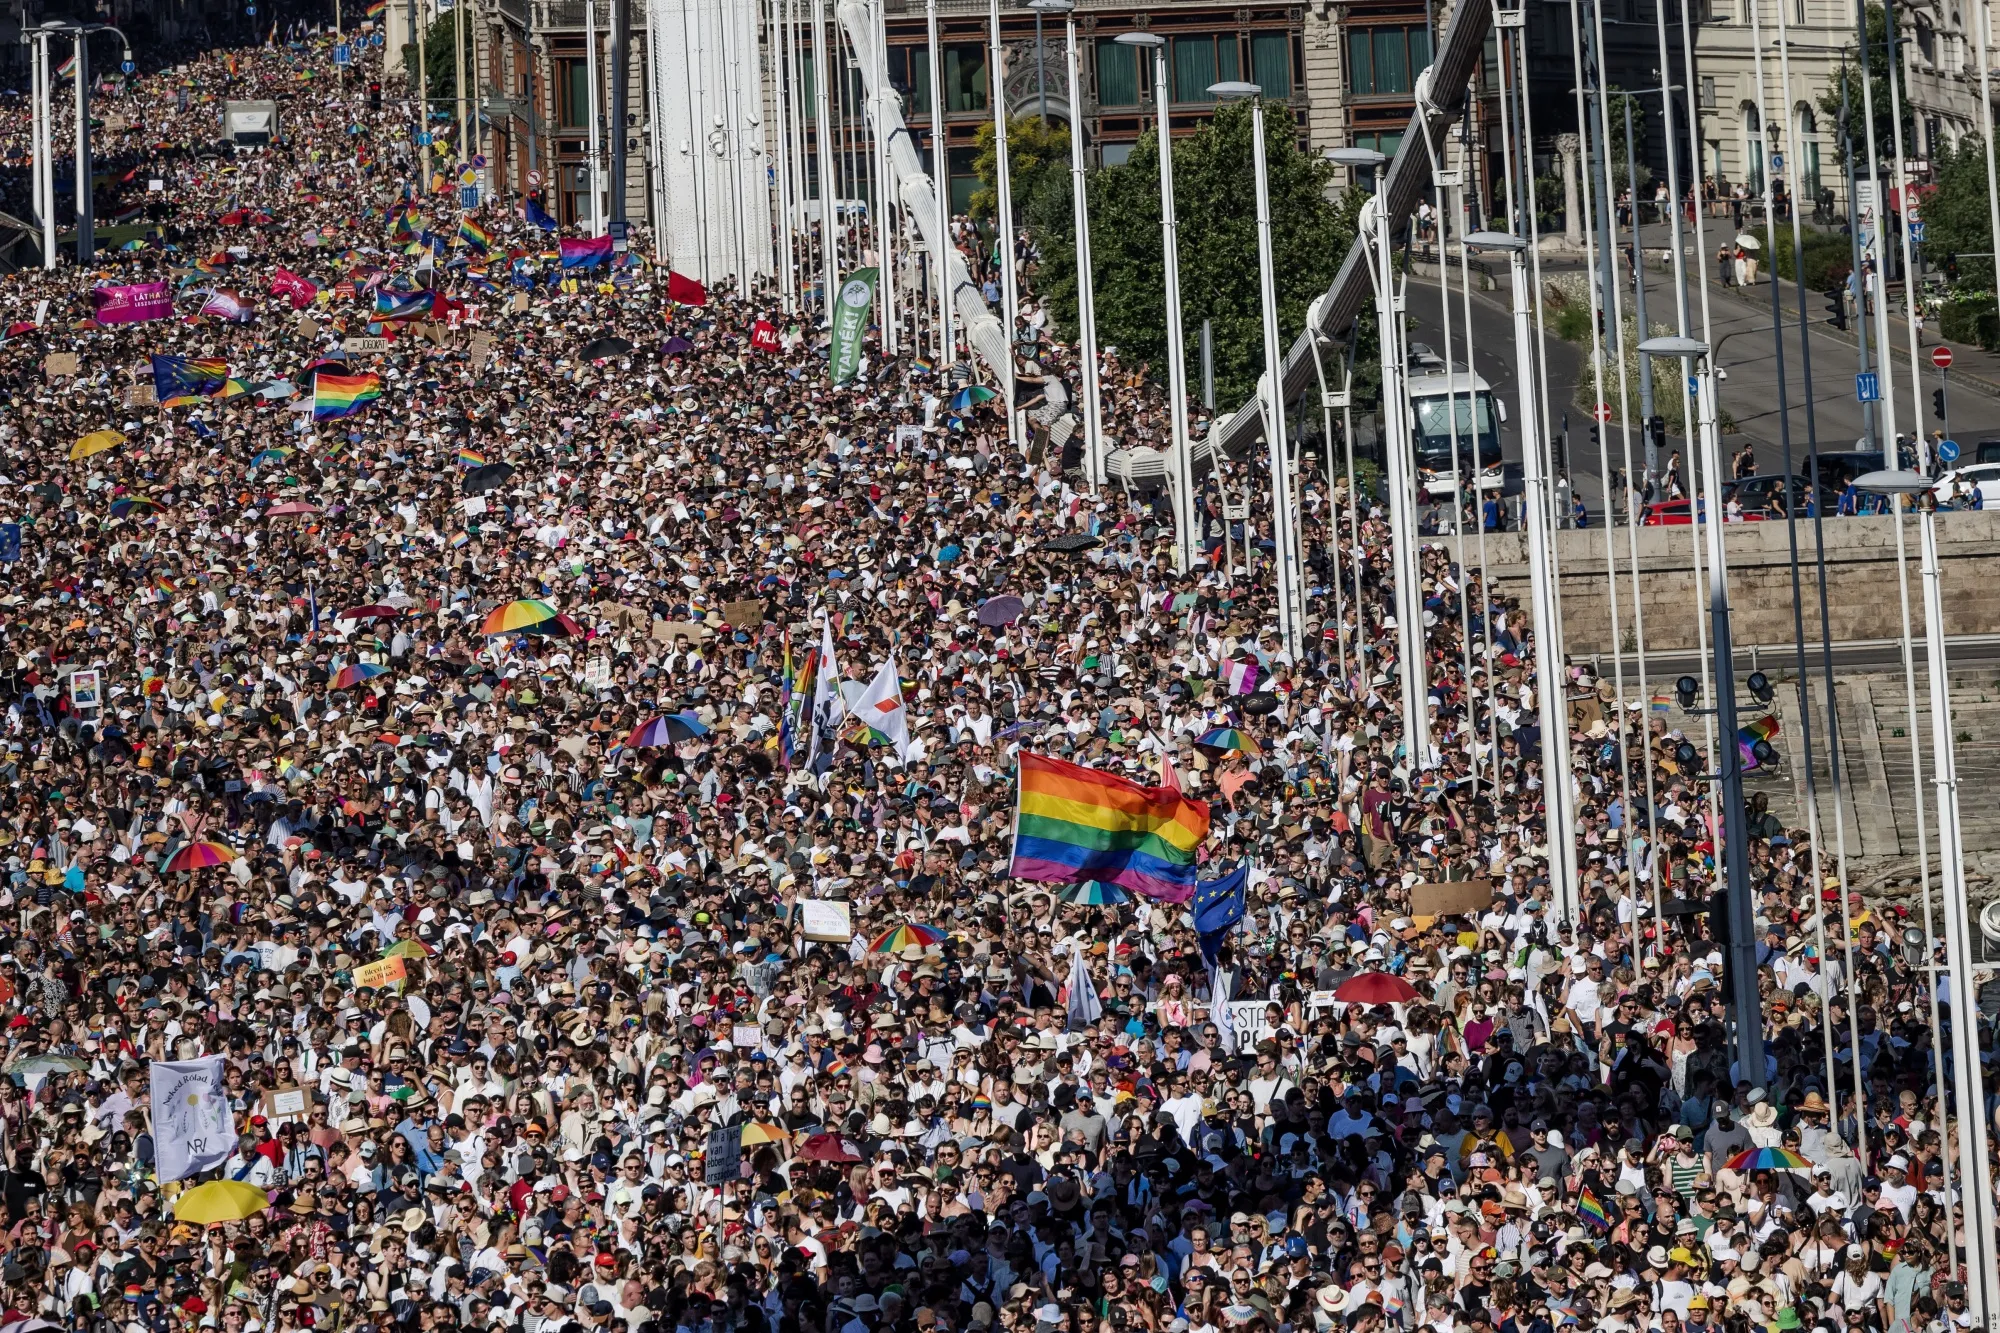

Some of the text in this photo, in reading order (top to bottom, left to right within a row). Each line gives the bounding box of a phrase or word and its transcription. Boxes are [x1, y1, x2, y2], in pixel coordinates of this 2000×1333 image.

[757, 330, 779, 344] MLK
[710, 1131, 719, 1144] Mi
[721, 1132, 725, 1142] a
[710, 1145, 723, 1155] van
[707, 1156, 725, 1168] ebben
